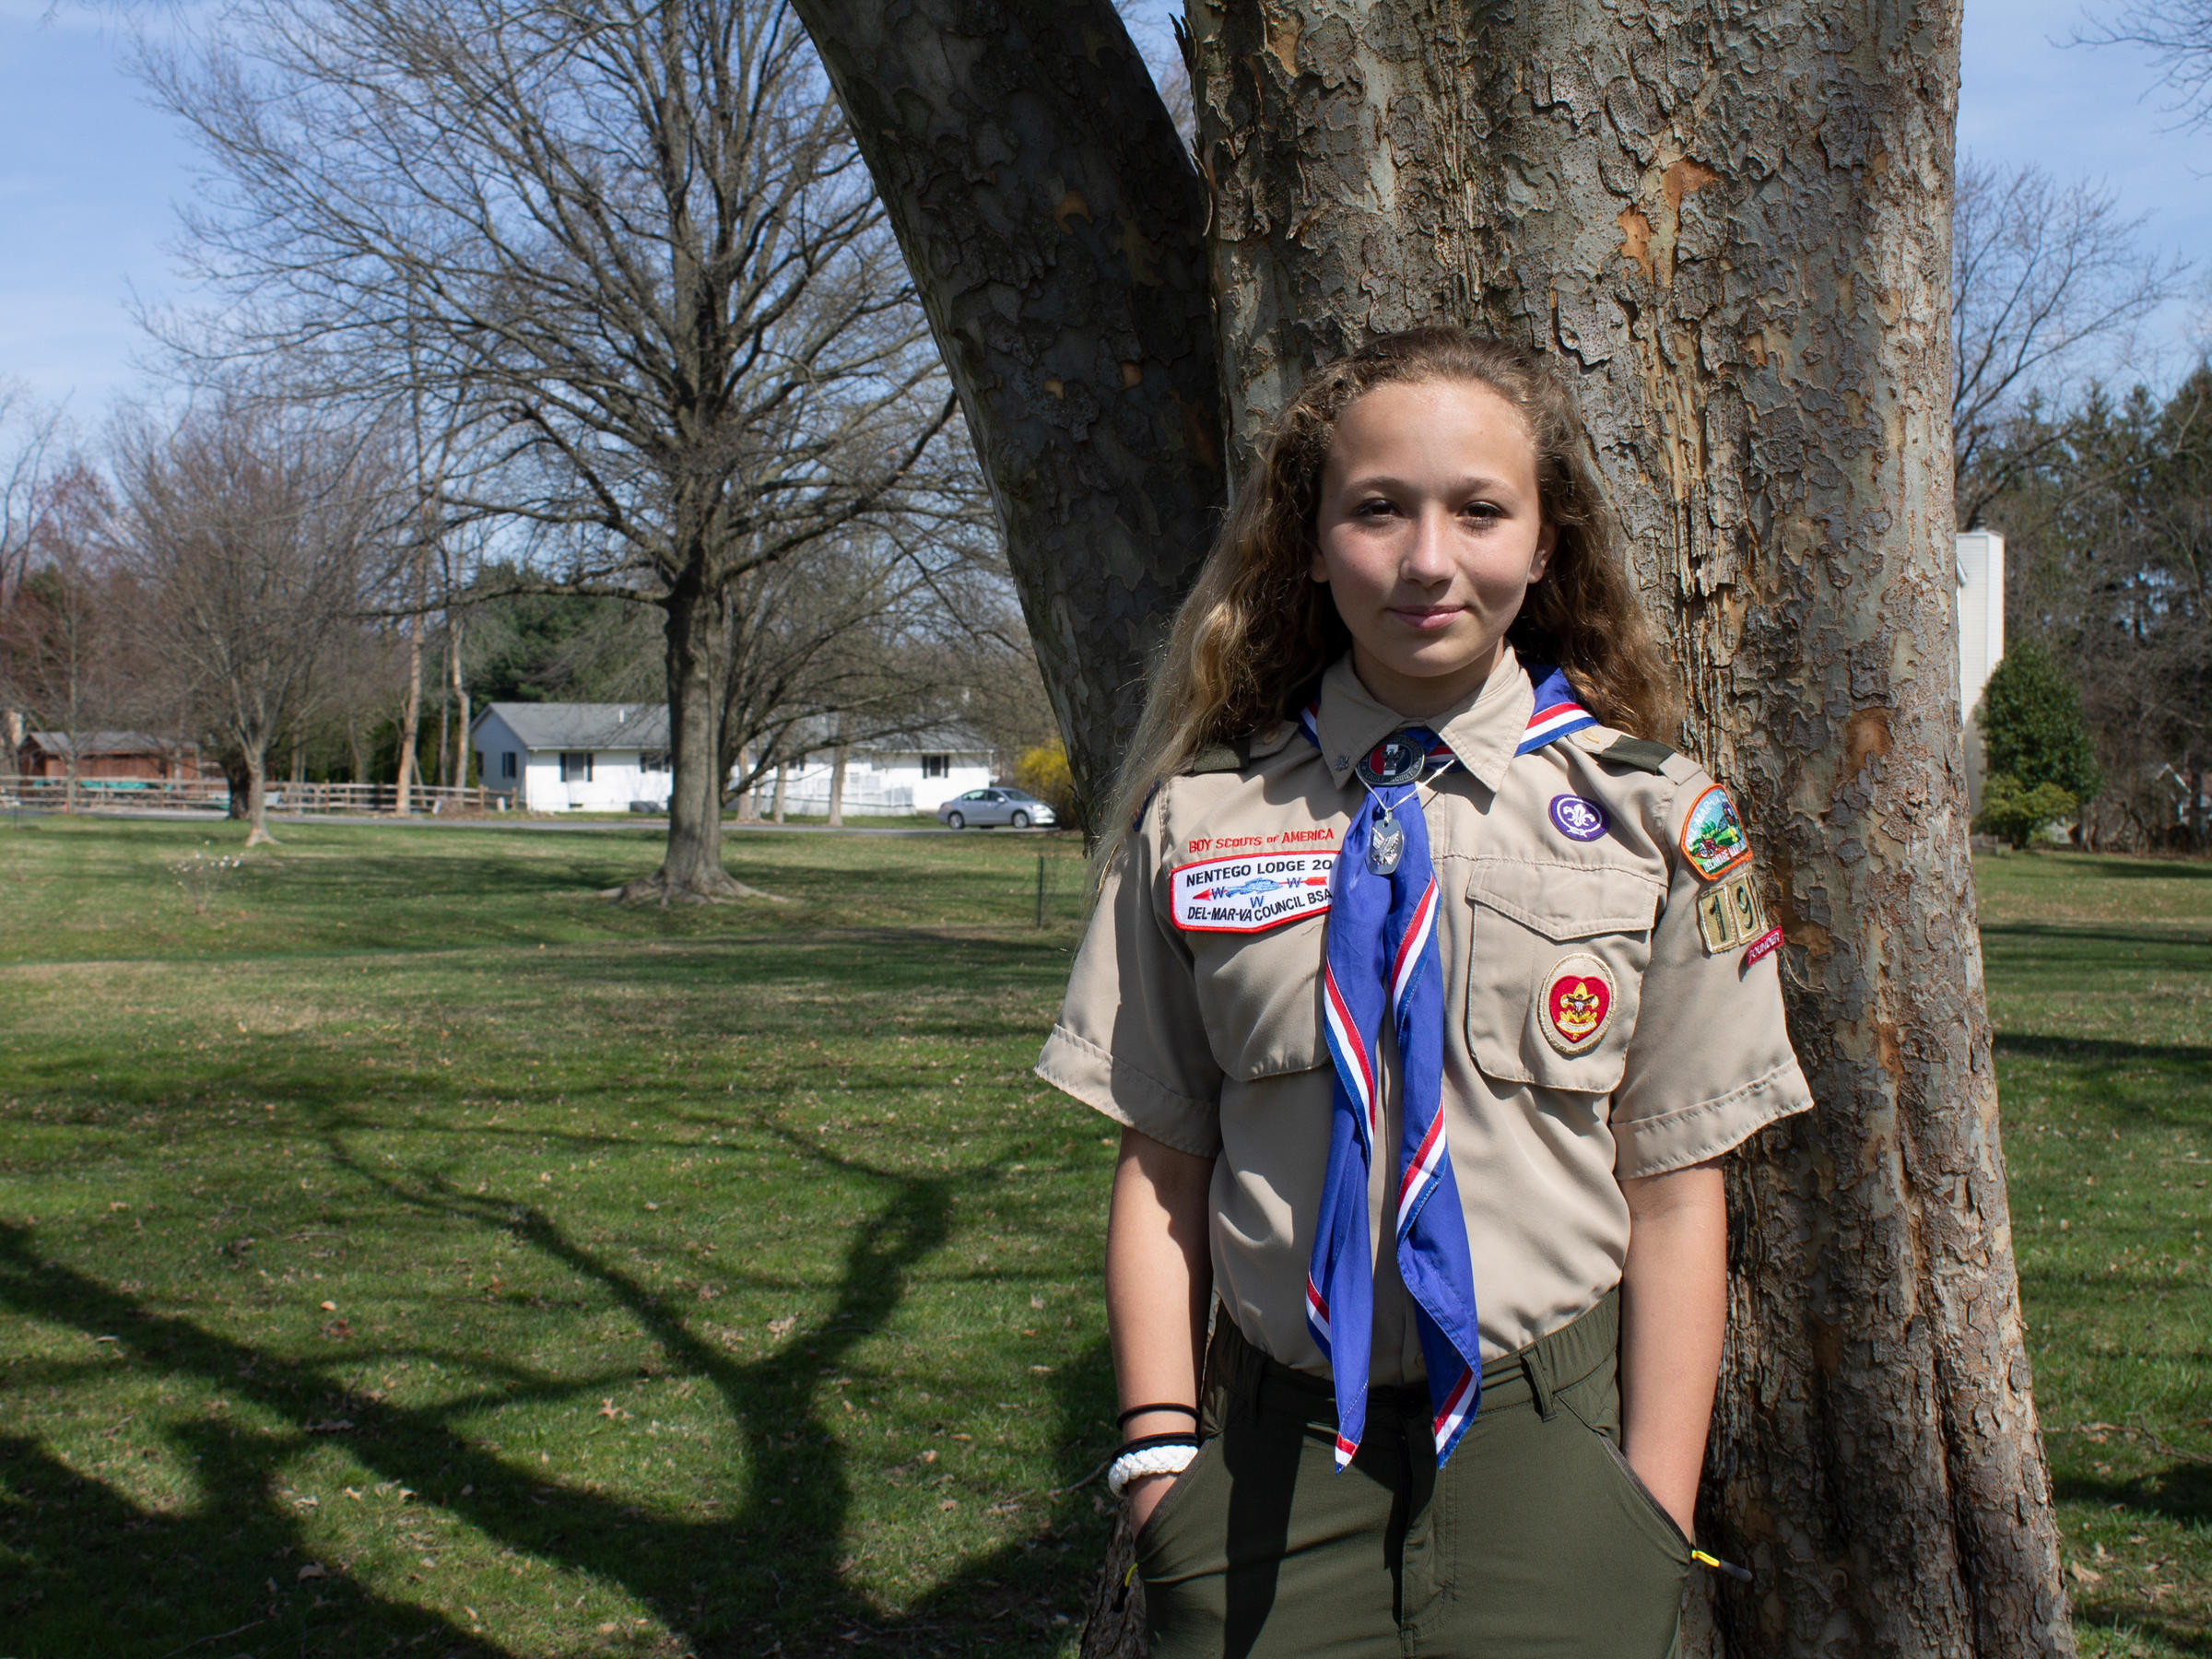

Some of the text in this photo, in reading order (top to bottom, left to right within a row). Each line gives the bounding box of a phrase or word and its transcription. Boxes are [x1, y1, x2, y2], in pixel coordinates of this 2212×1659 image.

[1189, 839, 1212, 853] BOY
[1216, 836, 1262, 850] SCOUTS
[1281, 828, 1335, 843] AMERICA
[1186, 864, 1252, 888] NENTEGO
[1257, 860, 1305, 875] LODGE
[1210, 877, 1301, 900] W W
[1187, 888, 1333, 922] DEL-MAR-VA COUNCIL BSA
[1250, 895, 1265, 909] W
[1709, 886, 1753, 942] 19
